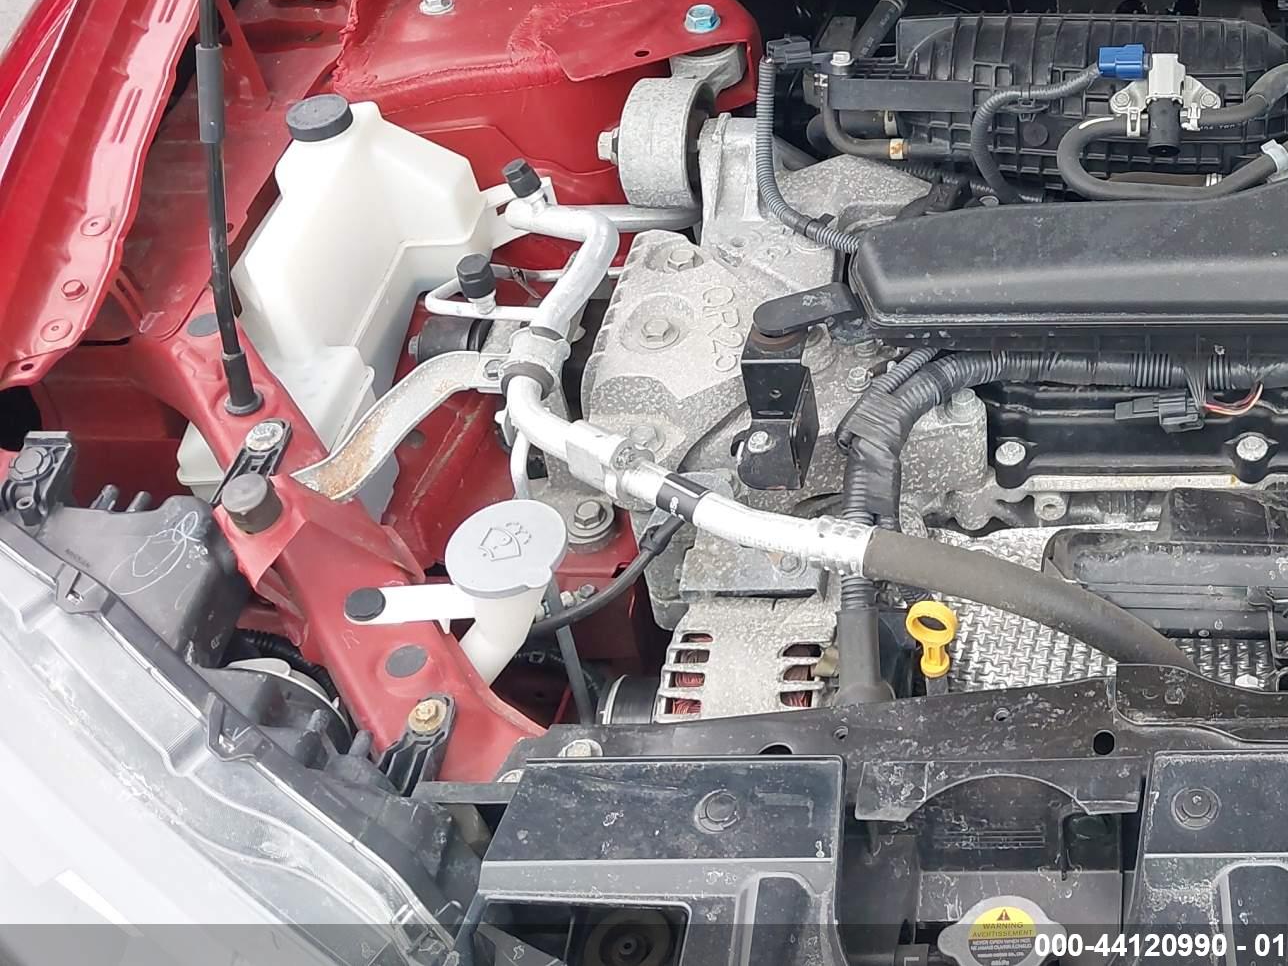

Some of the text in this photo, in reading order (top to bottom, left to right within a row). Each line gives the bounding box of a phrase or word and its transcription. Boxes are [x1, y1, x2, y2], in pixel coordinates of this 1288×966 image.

[703, 285, 745, 373] QR25
[982, 921, 1024, 930] WARNING
[972, 929, 1033, 938] AVERTISSEMENT
